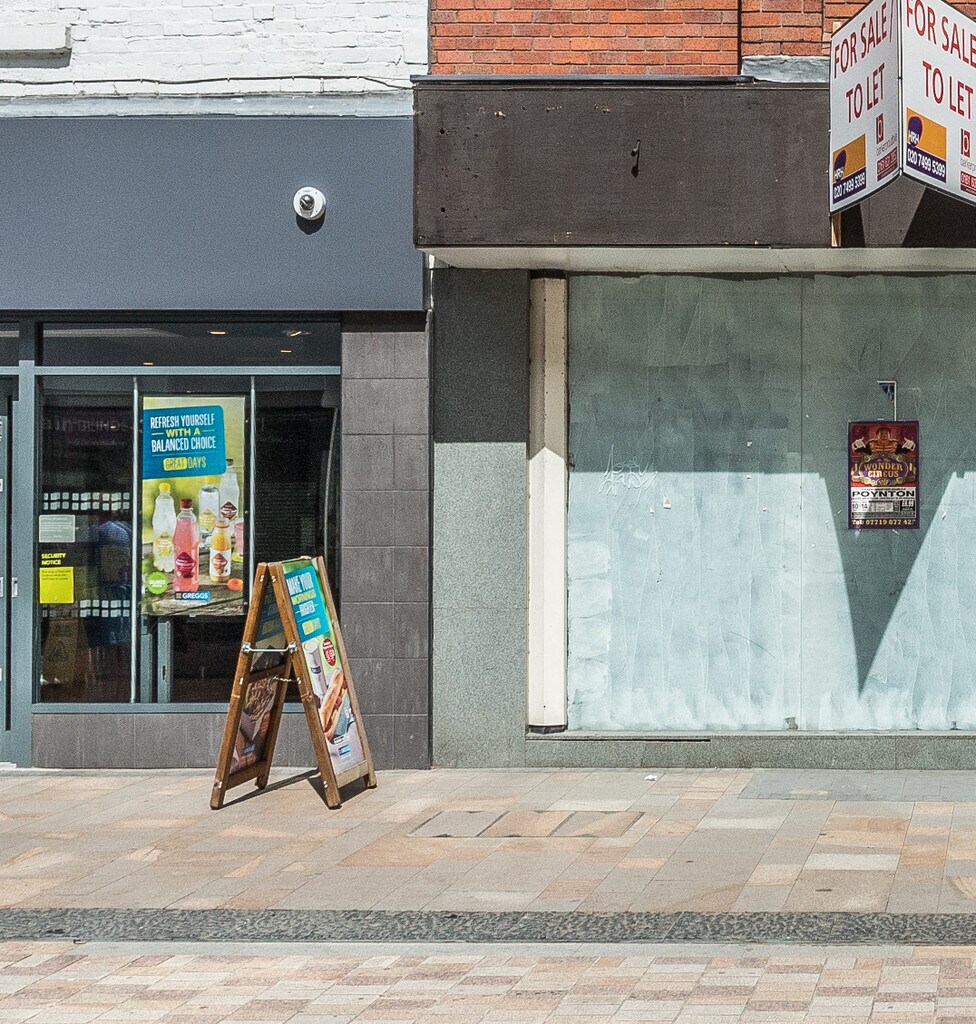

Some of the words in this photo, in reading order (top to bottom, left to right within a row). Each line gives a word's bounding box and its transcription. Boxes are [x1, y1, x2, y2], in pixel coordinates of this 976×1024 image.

[834, 31, 857, 79] FOR
[860, 1, 887, 58] SALE
[941, 16, 976, 69] SALE
[846, 82, 863, 123] TO
[866, 62, 885, 111] LET
[922, 60, 944, 104] TO
[949, 76, 974, 120] LET
[907, 148, 918, 165] 020
[918, 153, 932, 173] 7499
[931, 160, 946, 178] 5399
[150, 415, 180, 429] REFRESH
[180, 413, 215, 427] YOURSELF
[165, 428, 192, 438] WITH
[193, 427, 201, 436] A
[151, 437, 190, 453] BALANCED
[190, 436, 217, 450] CHOICE
[165, 457, 185, 470] GREAT
[187, 456, 207, 469] DAYS
[864, 462, 903, 472] WONDER
[868, 470, 899, 478] CIRCUS
[181, 592, 209, 600] GREGGS
